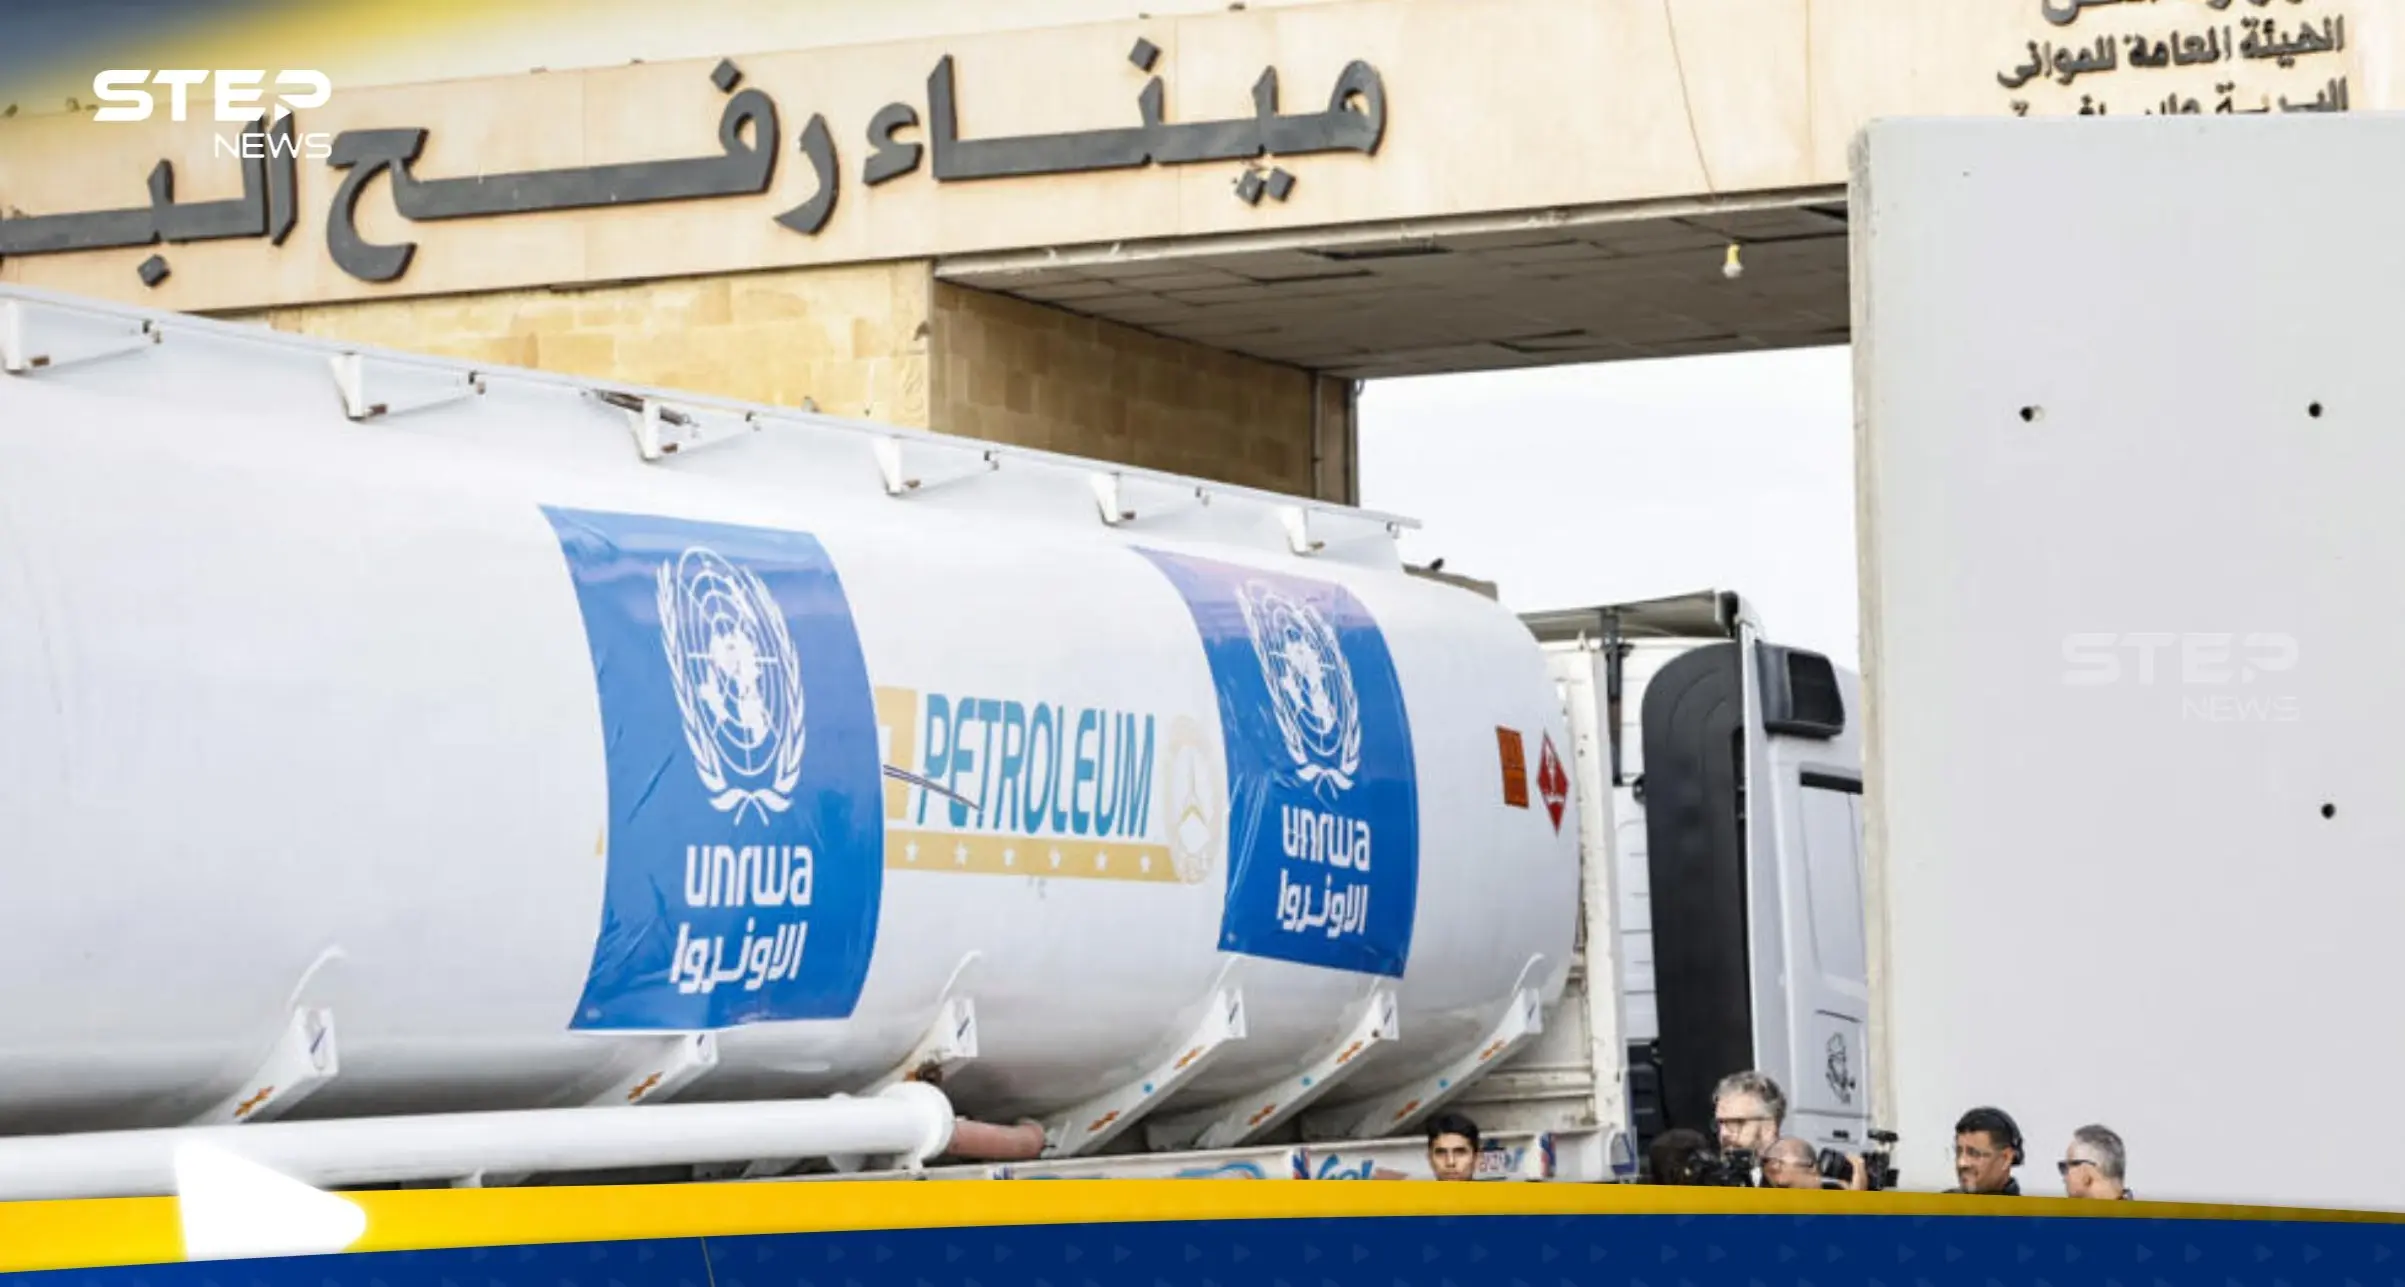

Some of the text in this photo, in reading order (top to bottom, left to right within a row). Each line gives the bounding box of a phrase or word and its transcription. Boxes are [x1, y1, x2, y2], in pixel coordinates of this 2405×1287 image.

[0, 36, 1387, 287] ميناء رفح الب
[917, 693, 1155, 838] PETROLEUM
[685, 845, 813, 907] unrwa
